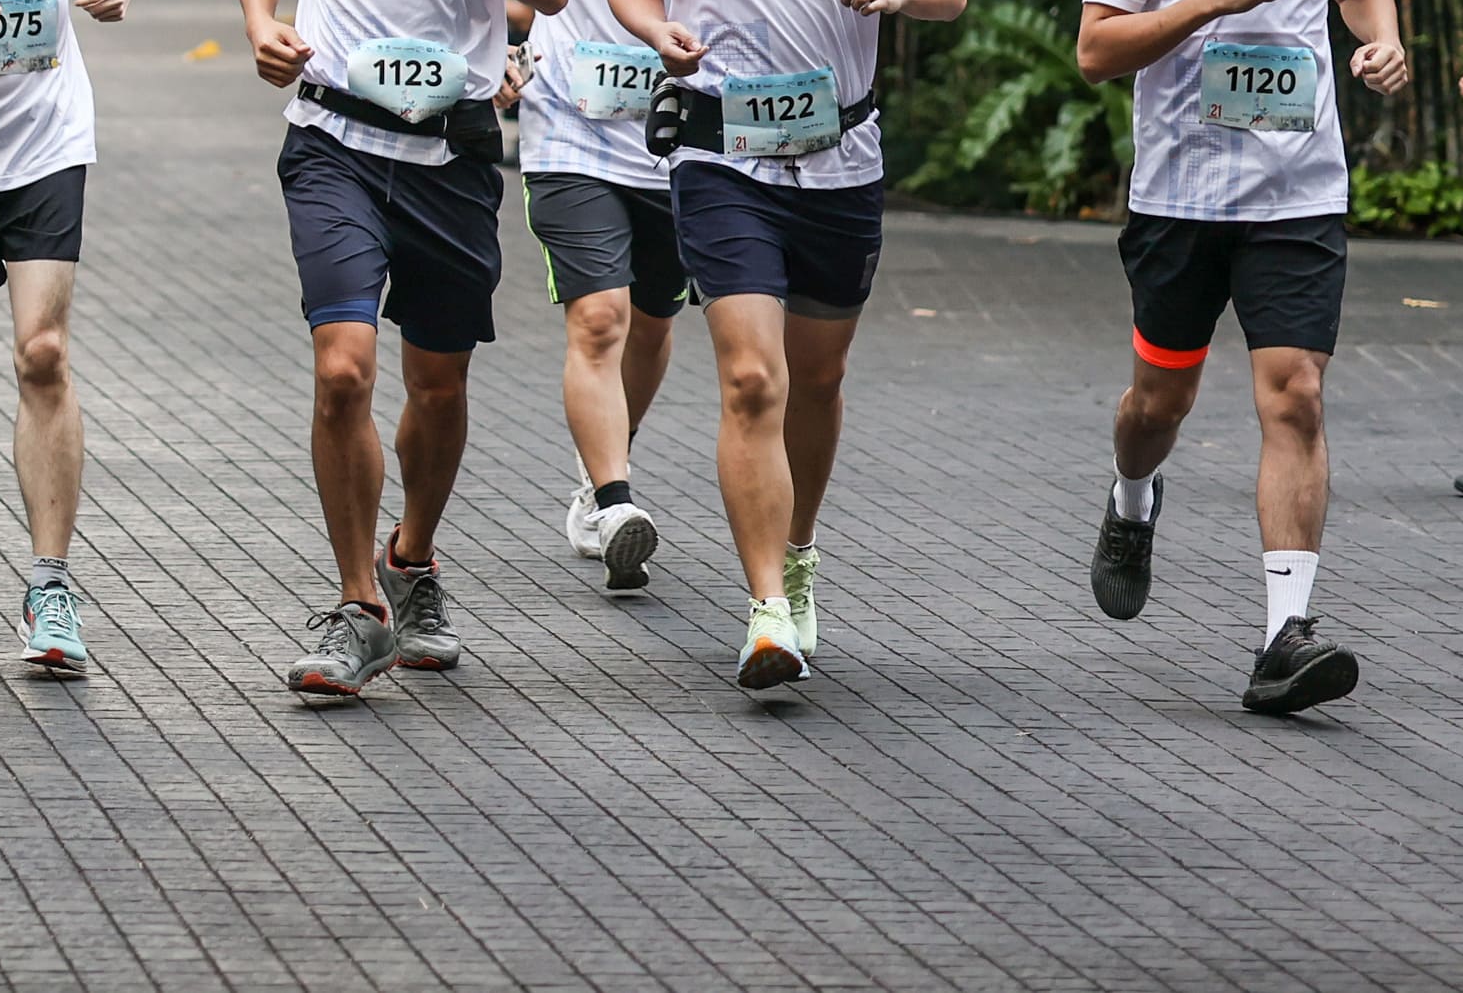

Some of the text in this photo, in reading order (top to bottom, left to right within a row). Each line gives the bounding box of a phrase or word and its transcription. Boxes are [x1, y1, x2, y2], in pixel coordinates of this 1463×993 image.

[373, 59, 442, 87] 1123
[595, 63, 652, 90] 1121
[1226, 66, 1296, 95] 1120
[745, 92, 815, 122] 1122
